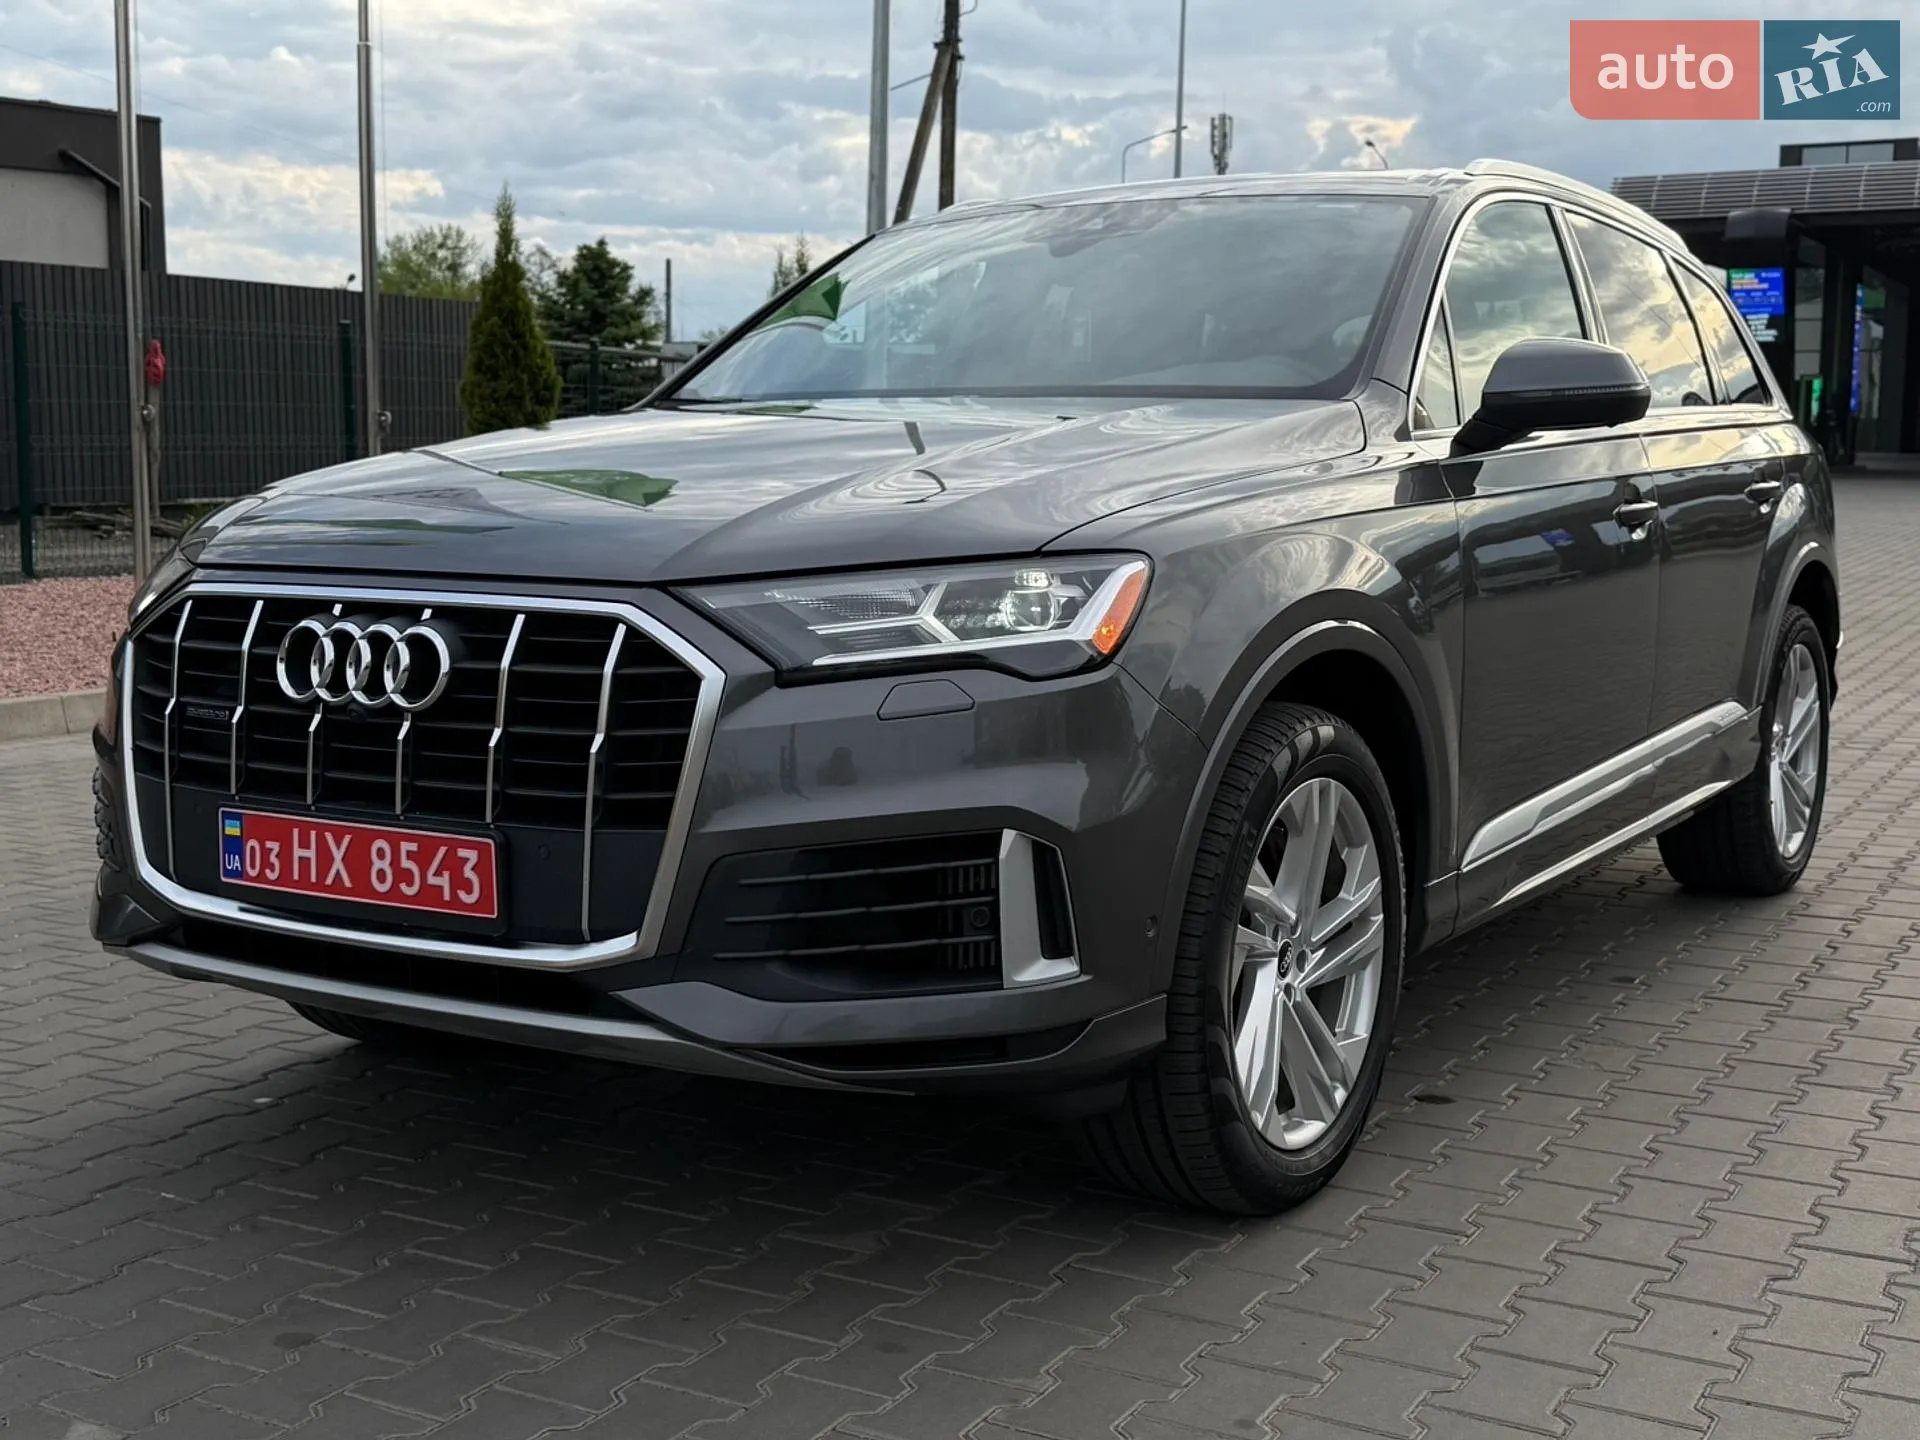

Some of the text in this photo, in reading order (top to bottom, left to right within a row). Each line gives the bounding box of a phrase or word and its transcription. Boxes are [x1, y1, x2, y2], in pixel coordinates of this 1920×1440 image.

[225, 852, 241, 871] UA
[245, 828, 480, 905] 03 HX 8543
